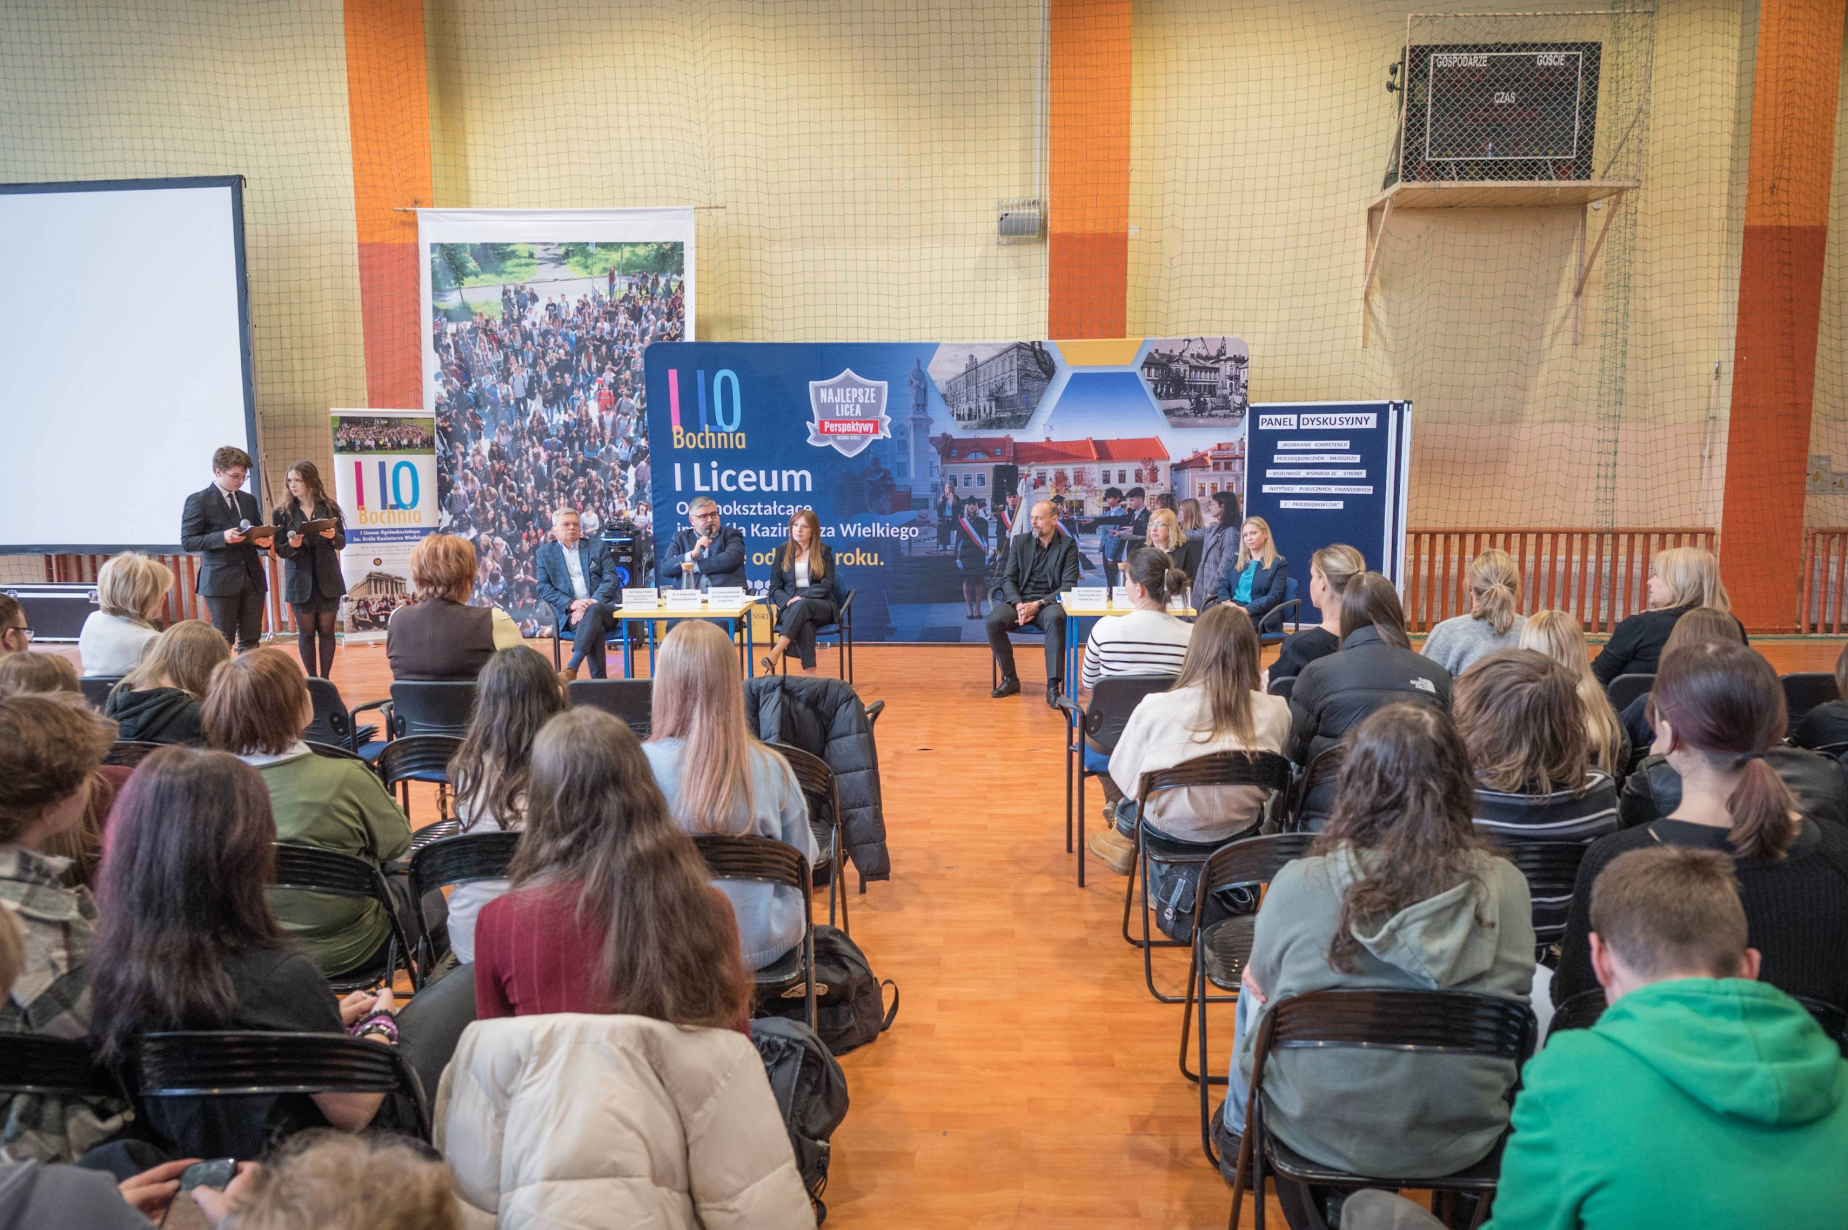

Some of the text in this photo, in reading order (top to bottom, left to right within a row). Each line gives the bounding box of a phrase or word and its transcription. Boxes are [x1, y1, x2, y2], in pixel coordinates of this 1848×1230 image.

[1436, 55, 1488, 68] GOSPODARZE
[1494, 91, 1516, 104] CZAS
[820, 387, 876, 404] NAJLEPSZE
[835, 403, 862, 417] LICEA
[824, 421, 874, 434] Perspektywy
[1260, 416, 1370, 427] PANEL DYSKUSYJNY
[672, 423, 747, 450] Bochnia
[674, 460, 813, 492] I Liceum
[357, 504, 422, 525] Bochnia
[840, 522, 919, 540] Wielkiego
[834, 547, 886, 566] roku.
